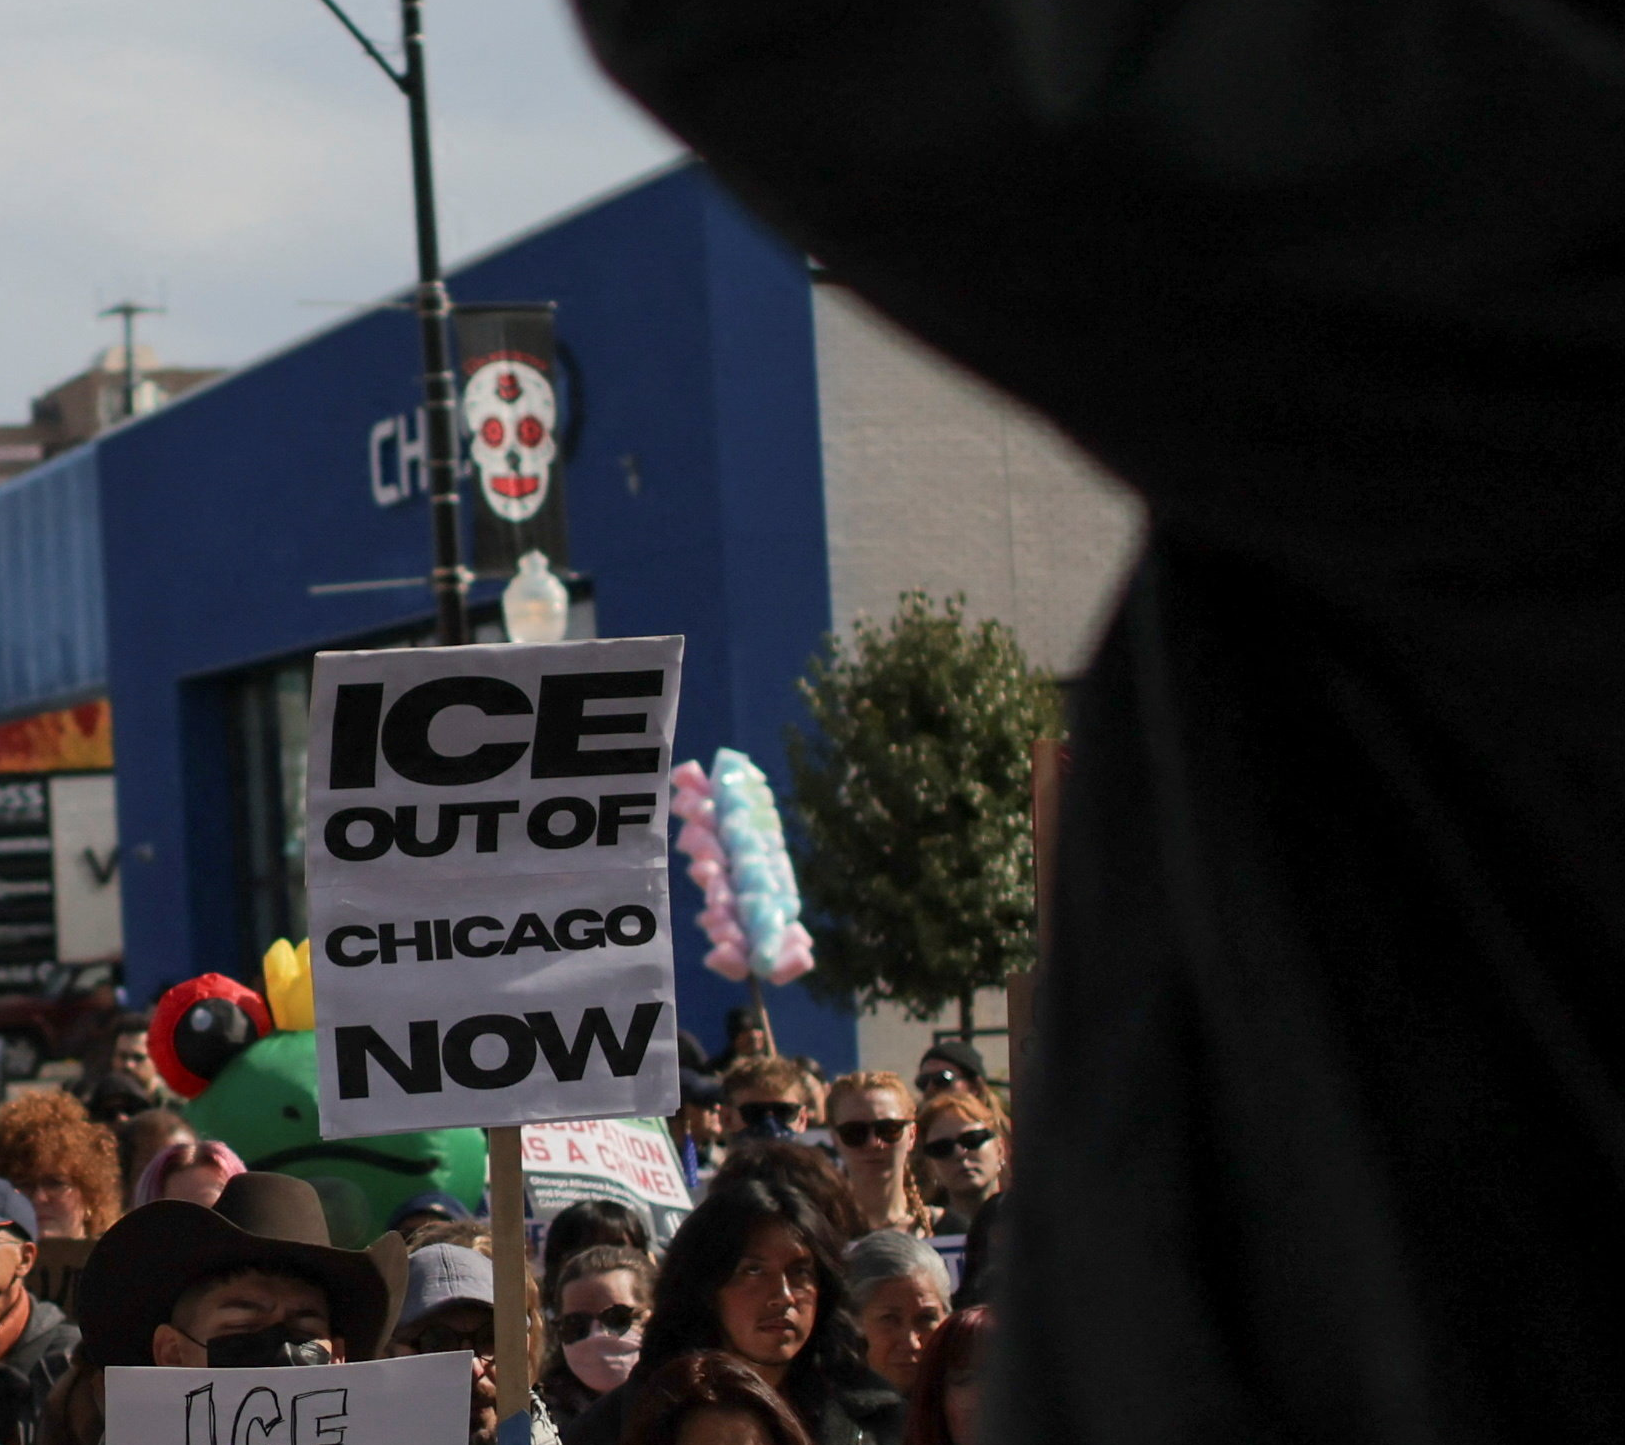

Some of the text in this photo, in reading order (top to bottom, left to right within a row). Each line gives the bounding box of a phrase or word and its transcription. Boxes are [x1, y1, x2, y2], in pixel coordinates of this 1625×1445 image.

[329, 669, 666, 790] ICE
[323, 792, 657, 863] OUT OF
[323, 904, 657, 967] CHICAGO
[335, 1001, 664, 1101] NOW
[566, 1139, 588, 1165] A
[595, 1142, 680, 1198] CRIME!
